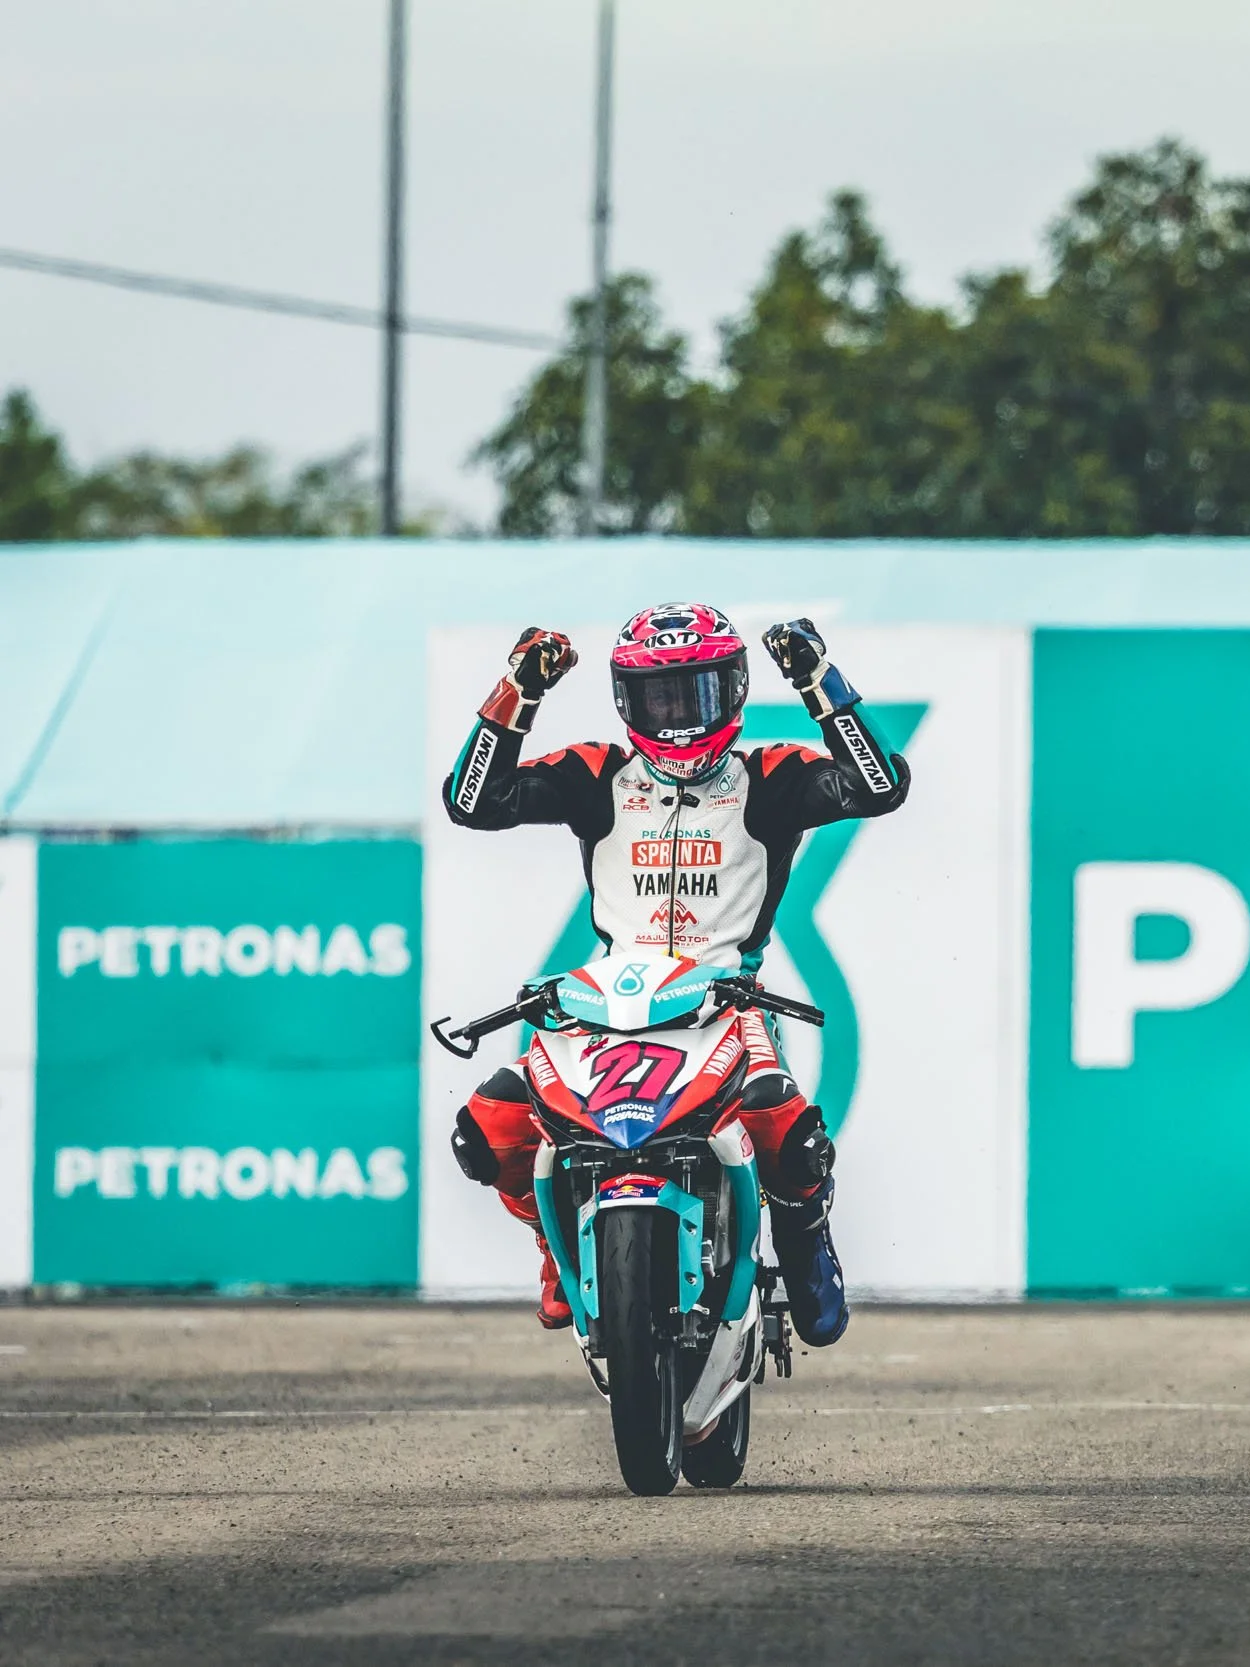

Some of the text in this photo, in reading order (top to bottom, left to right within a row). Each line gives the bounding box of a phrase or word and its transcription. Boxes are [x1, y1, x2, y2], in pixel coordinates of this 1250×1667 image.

[650, 631, 696, 647] KYT
[674, 726, 706, 737] RCB
[663, 764, 692, 777] racing
[642, 829, 711, 839] PERONAS
[633, 873, 718, 896] YAMAHA
[58, 924, 411, 978] PETRONAS
[557, 987, 604, 1006] ETRONAS
[703, 1034, 743, 1078] YAMAHA
[529, 1046, 558, 1091] YAMAHA
[584, 1041, 686, 1113] 27
[603, 1110, 657, 1127] PRIMAX
[604, 1103, 655, 1117] PETRONAS
[54, 1146, 408, 1200] PETRONAS
